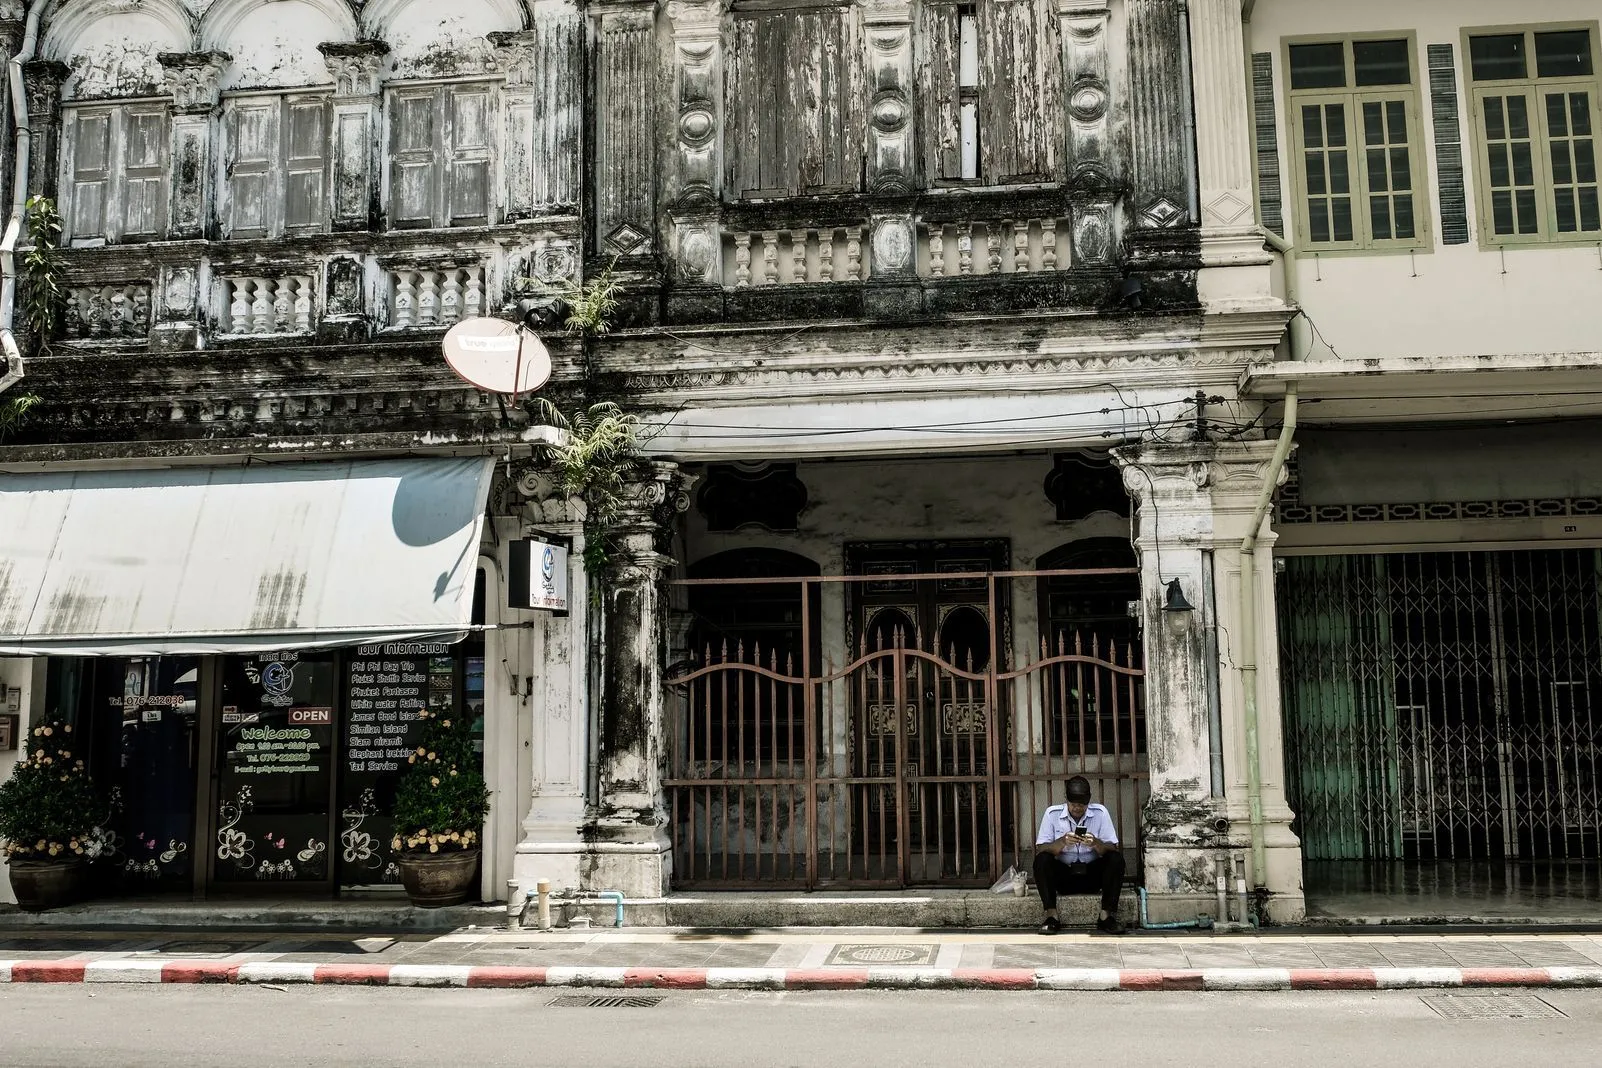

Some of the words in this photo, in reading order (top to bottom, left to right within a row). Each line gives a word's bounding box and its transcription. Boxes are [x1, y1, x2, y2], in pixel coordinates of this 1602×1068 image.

[384, 642, 448, 655] Information
[351, 661, 365, 672] Phi
[367, 661, 381, 672] Phi
[383, 661, 399, 672] Day
[401, 660, 415, 672] Trip
[351, 673, 375, 684] Phuket
[377, 673, 400, 684] Shuttle
[402, 672, 427, 683] Service
[351, 687, 380, 697] Phuket
[382, 686, 419, 696] Fantasea
[351, 698, 373, 710] White
[375, 699, 397, 709] water
[399, 698, 426, 709] Rafting
[292, 710, 328, 721] OPEN
[350, 711, 375, 722] James
[377, 711, 397, 721] Bond
[350, 723, 381, 734] Similan
[383, 723, 409, 734] Island
[235, 742, 256, 752] Open
[349, 736, 372, 747] Siam
[349, 748, 384, 759] Elephant
[386, 747, 417, 758] trekkin
[349, 760, 365, 772] Taxi
[367, 759, 399, 771] Service
